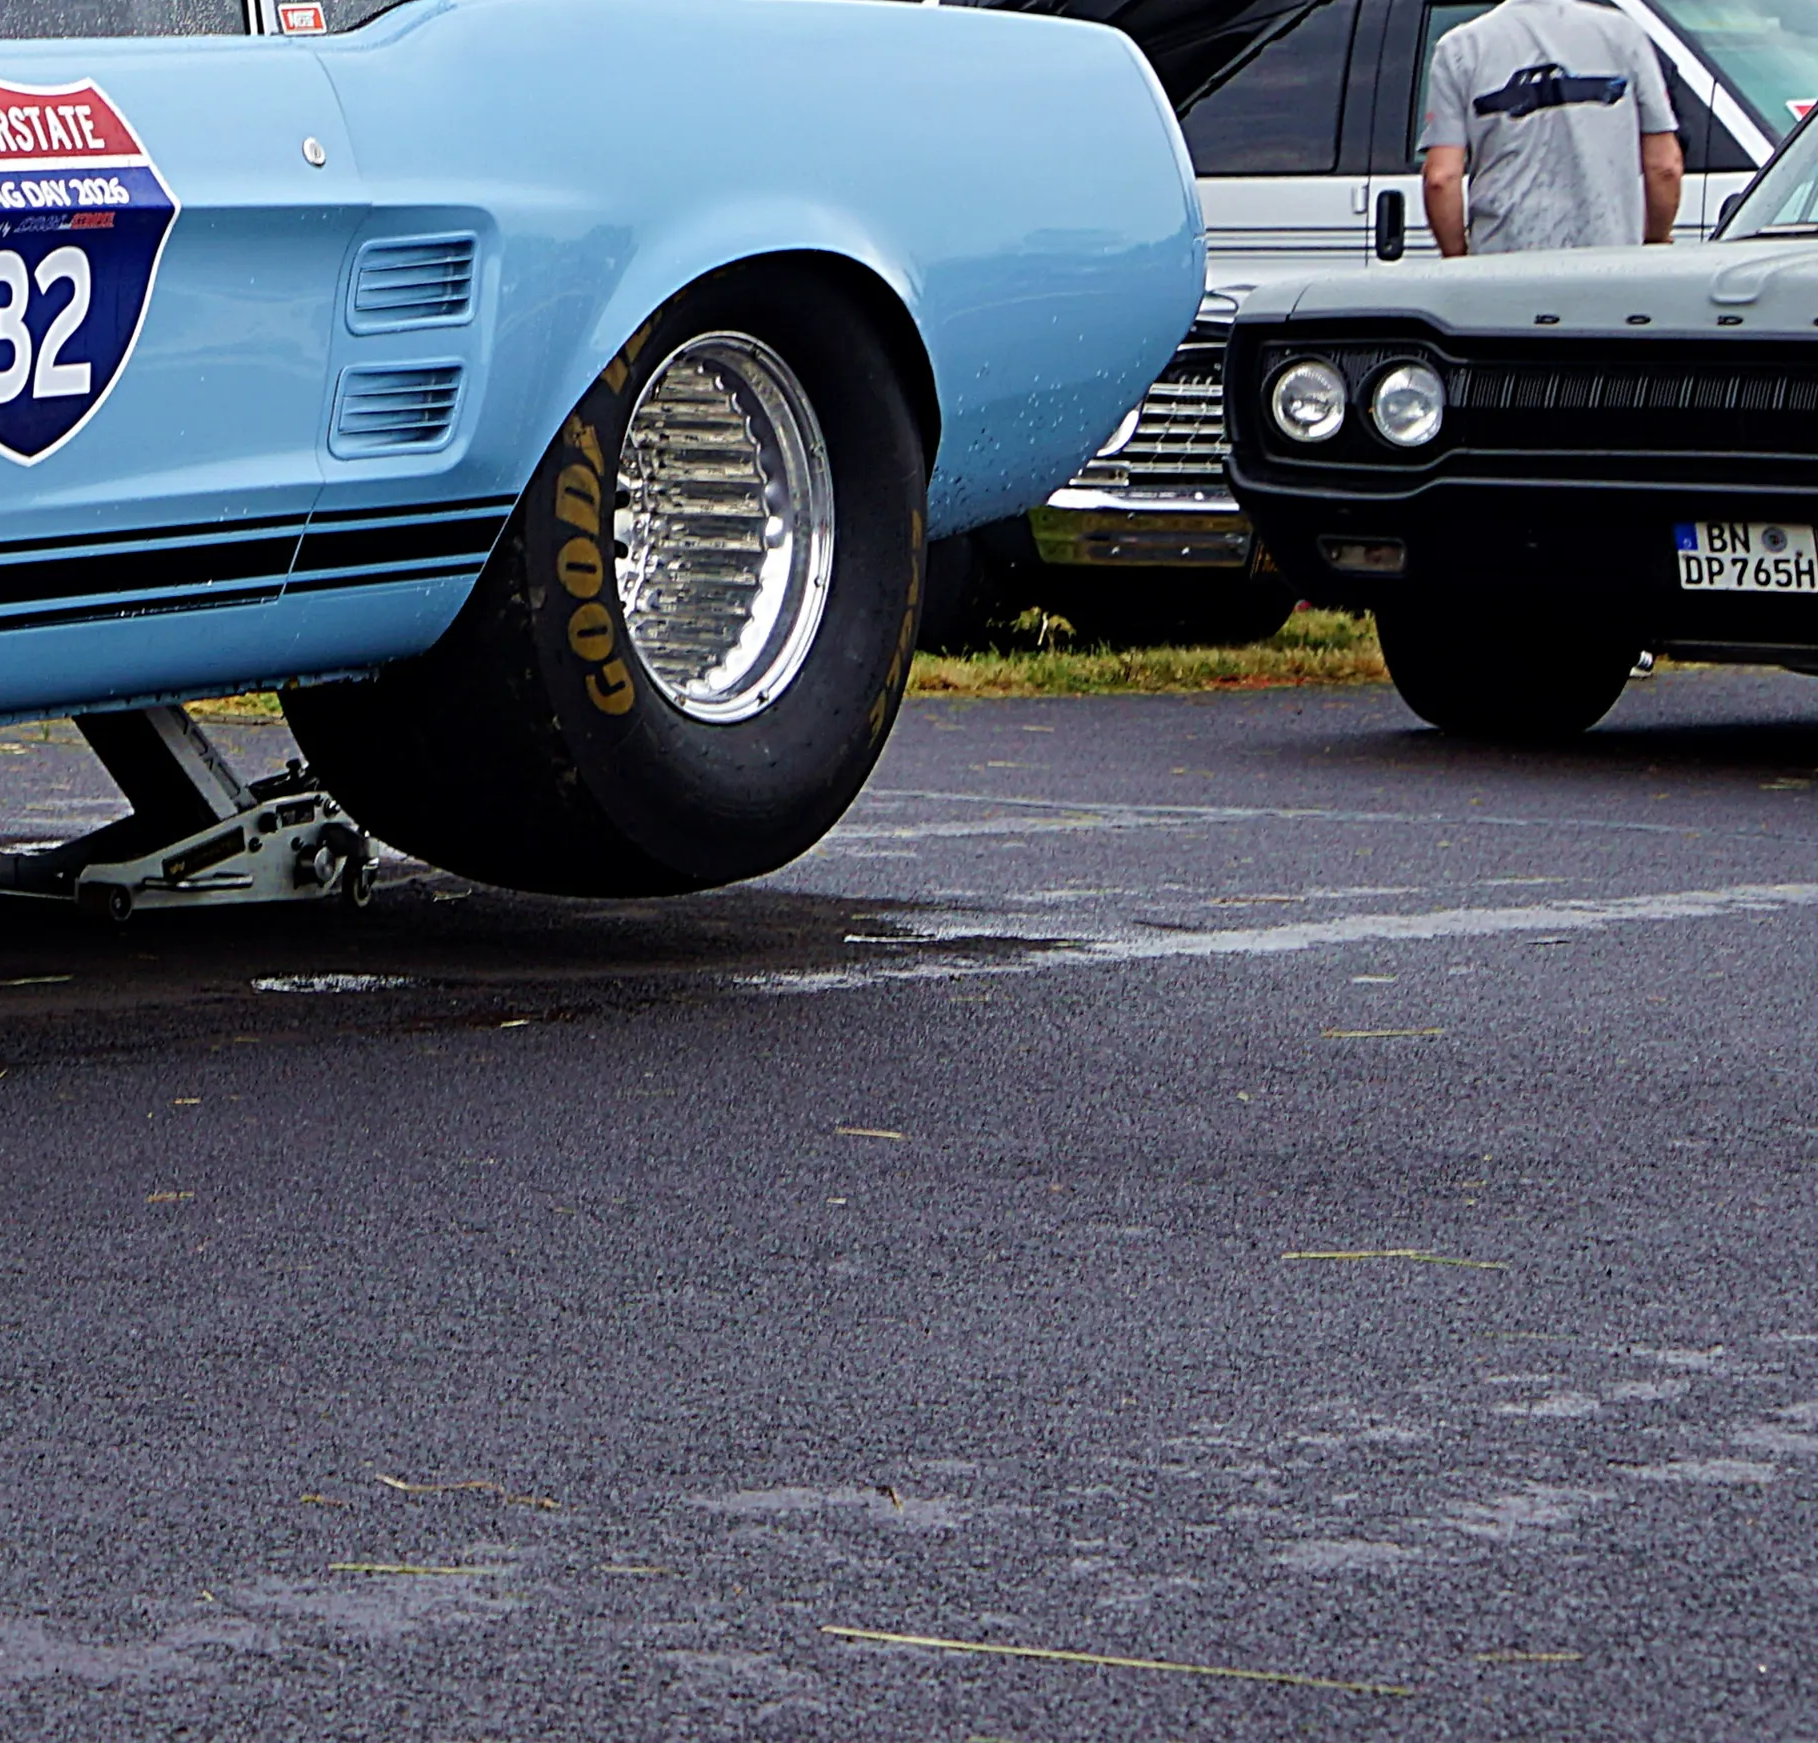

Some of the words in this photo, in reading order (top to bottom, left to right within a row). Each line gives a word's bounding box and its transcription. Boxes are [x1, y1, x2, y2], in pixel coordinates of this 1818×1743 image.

[21, 180, 71, 208] DAY
[69, 177, 130, 206] 2026
[1706, 523, 1751, 554] BN
[1684, 556, 1725, 586] DP
[1731, 557, 1816, 589] 765H
